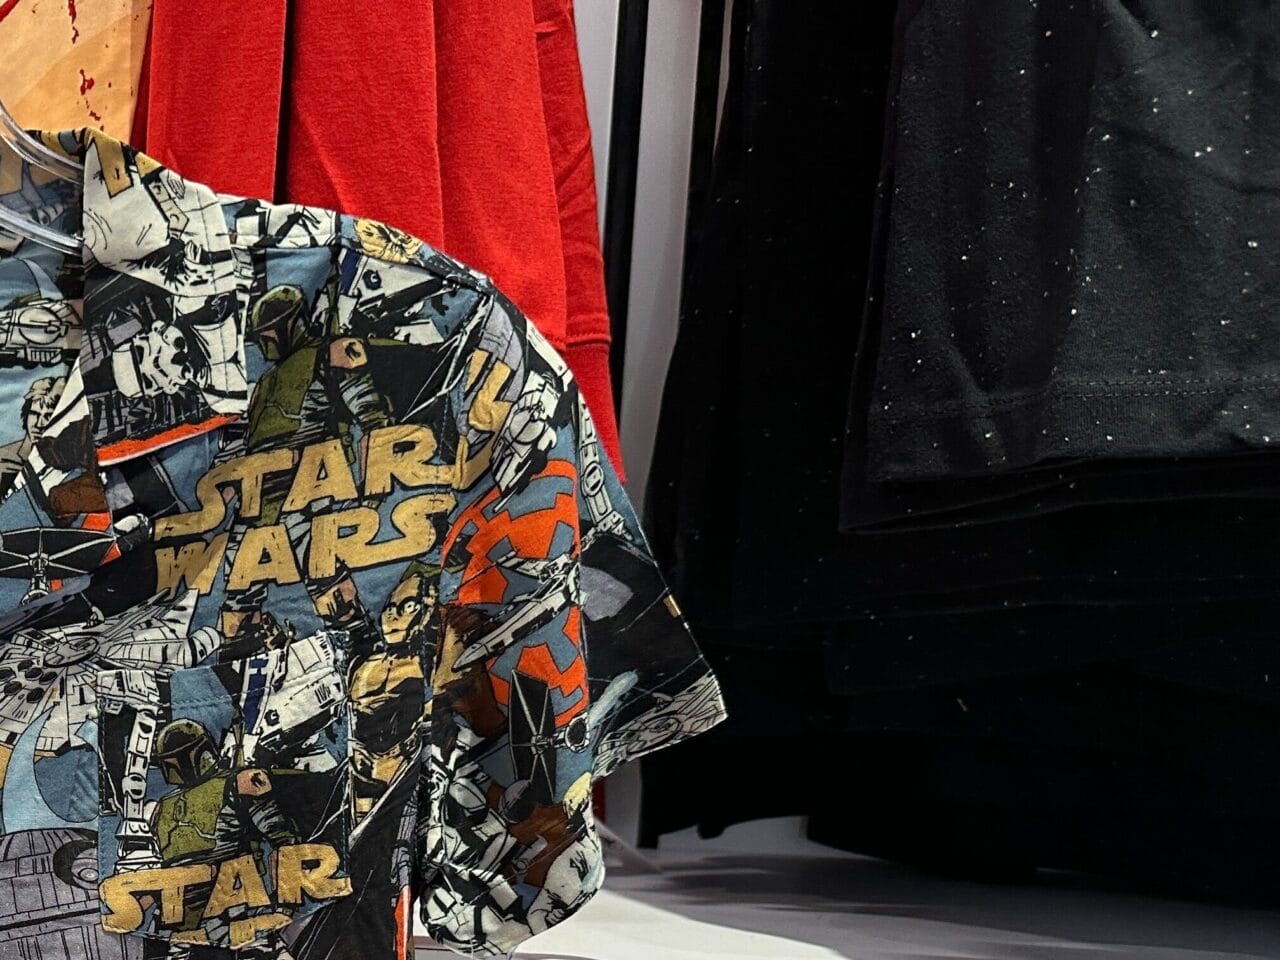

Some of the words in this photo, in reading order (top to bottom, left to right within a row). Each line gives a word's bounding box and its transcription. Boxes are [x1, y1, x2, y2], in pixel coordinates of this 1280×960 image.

[154, 424, 455, 541] STAR
[154, 493, 457, 598] WARS
[98, 843, 354, 934] STAR
